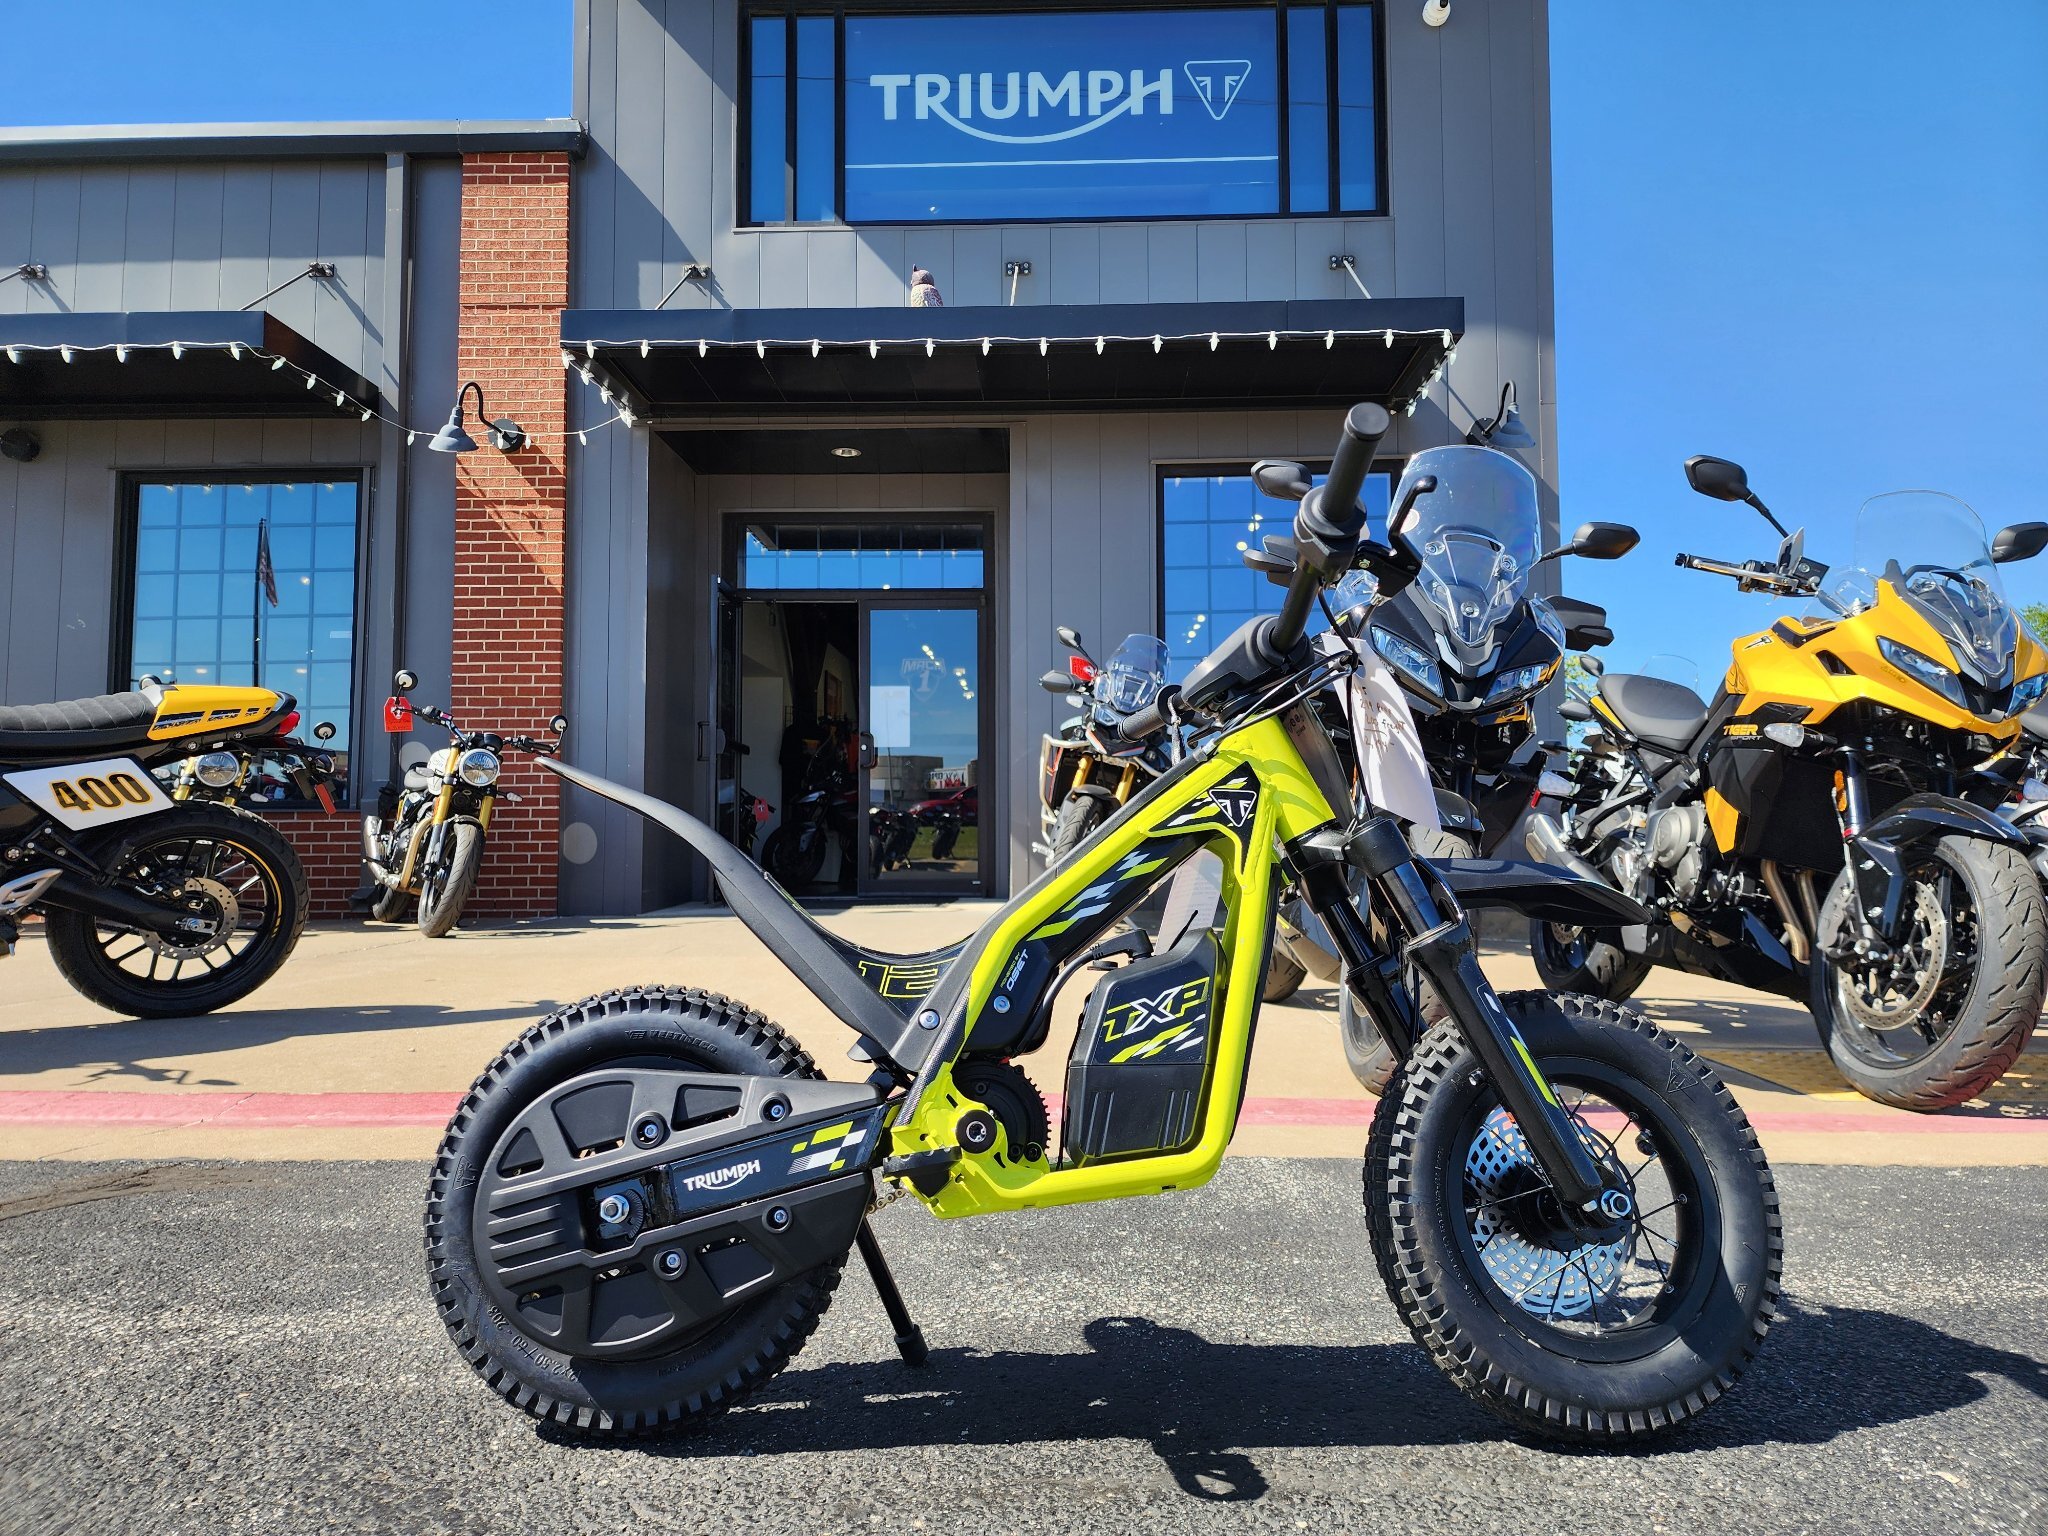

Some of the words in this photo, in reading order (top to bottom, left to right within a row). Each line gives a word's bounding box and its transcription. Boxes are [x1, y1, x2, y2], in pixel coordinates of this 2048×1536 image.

[869, 68, 1174, 144] TRIUMPH
[1723, 723, 1759, 736] TIGER
[49, 771, 153, 813] 400
[1006, 948, 1029, 991] OSET
[1103, 976, 1210, 1043] TXP
[683, 1159, 761, 1192] TRIUMPH
